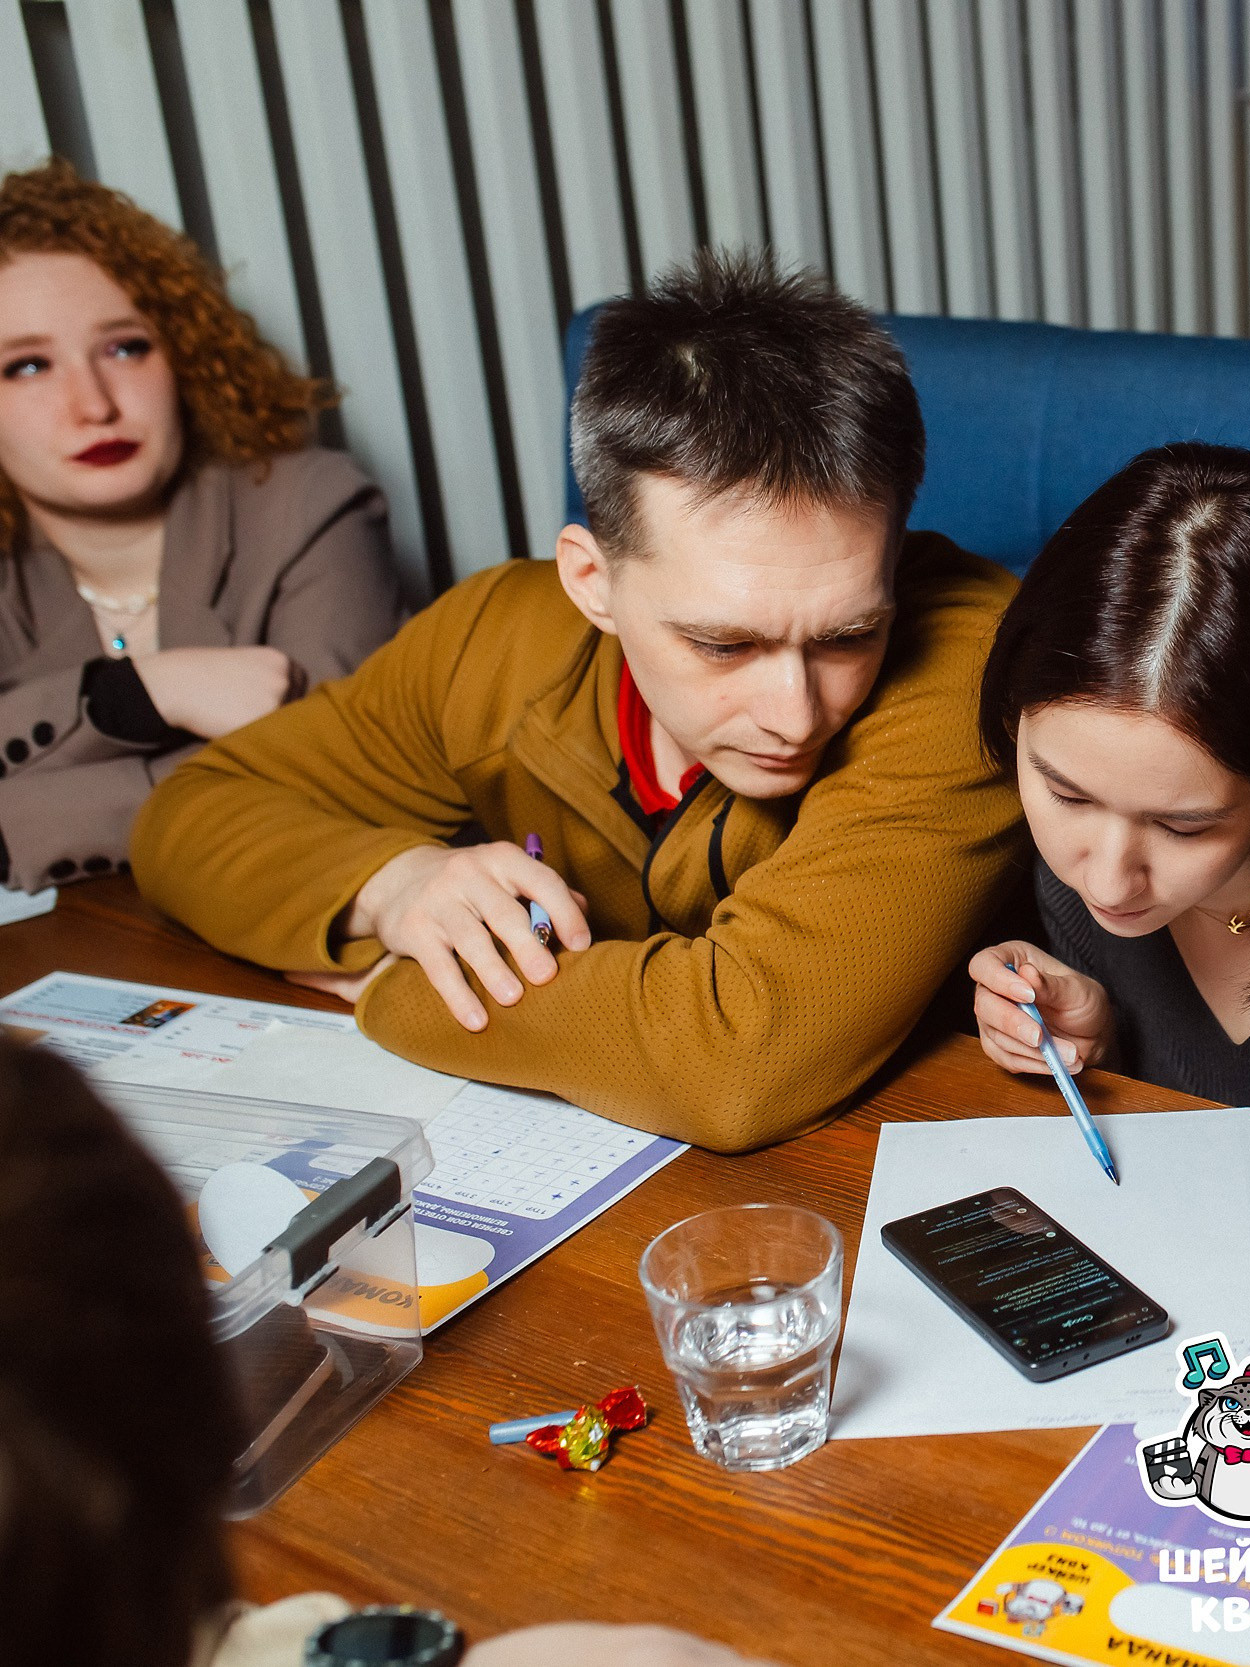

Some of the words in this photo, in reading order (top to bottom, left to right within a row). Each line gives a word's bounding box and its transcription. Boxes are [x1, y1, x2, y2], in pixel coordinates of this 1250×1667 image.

[445, 1216, 472, 1226] СВОИ
[472, 1222, 513, 1235] СВЕРЯЕМ
[1062, 1314, 1093, 1328] Google
